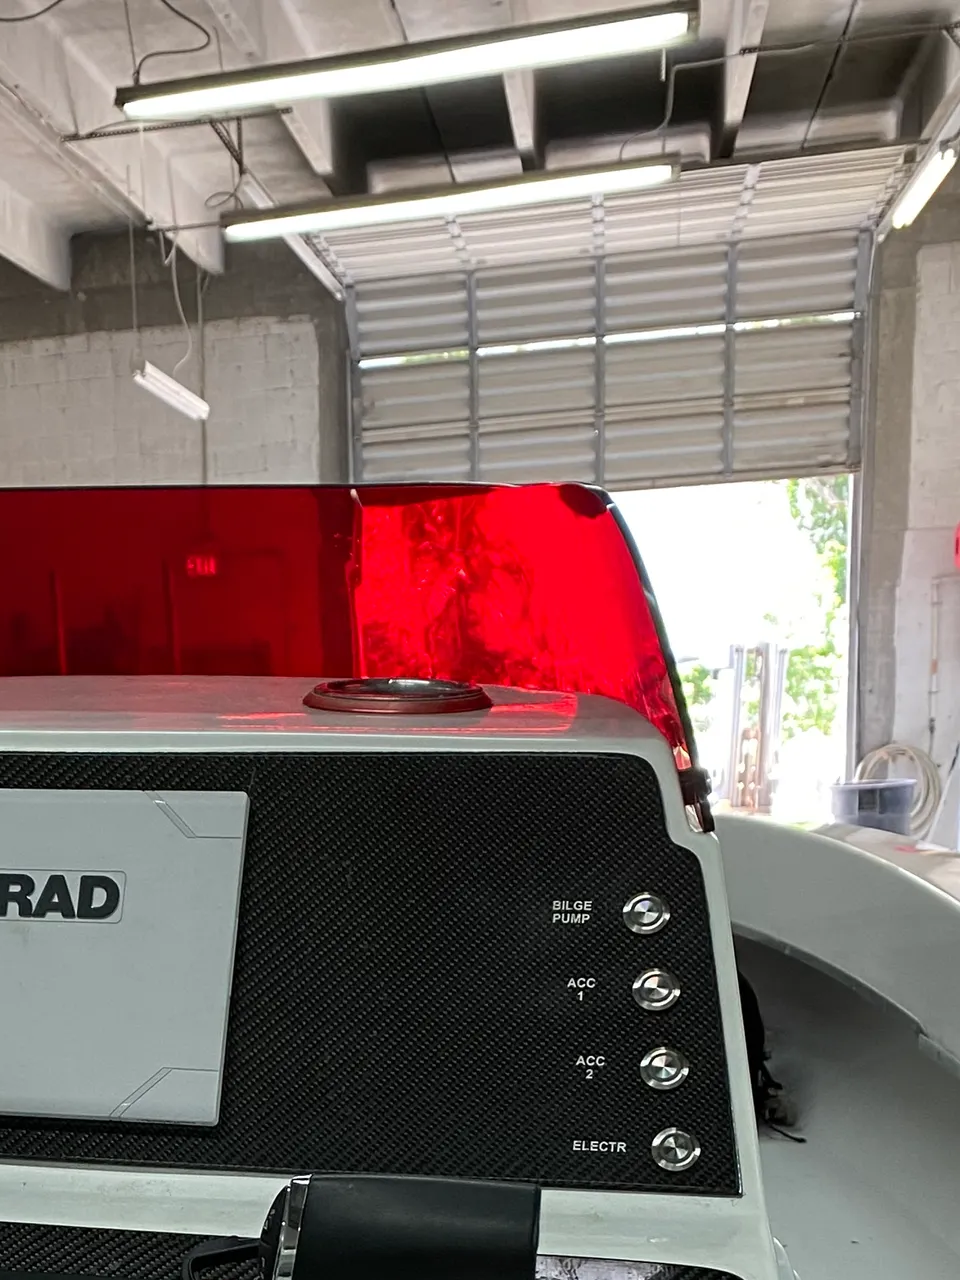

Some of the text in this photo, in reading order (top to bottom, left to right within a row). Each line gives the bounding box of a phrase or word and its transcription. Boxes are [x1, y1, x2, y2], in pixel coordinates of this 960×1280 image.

[552, 900, 593, 912] BILGE
[552, 912, 591, 924] PUMP
[567, 977, 596, 988] ACC
[577, 991, 584, 1001] 1
[575, 1055, 606, 1066] ACC
[585, 1069, 594, 1079] 2
[572, 1140, 627, 1152] ELECTR
